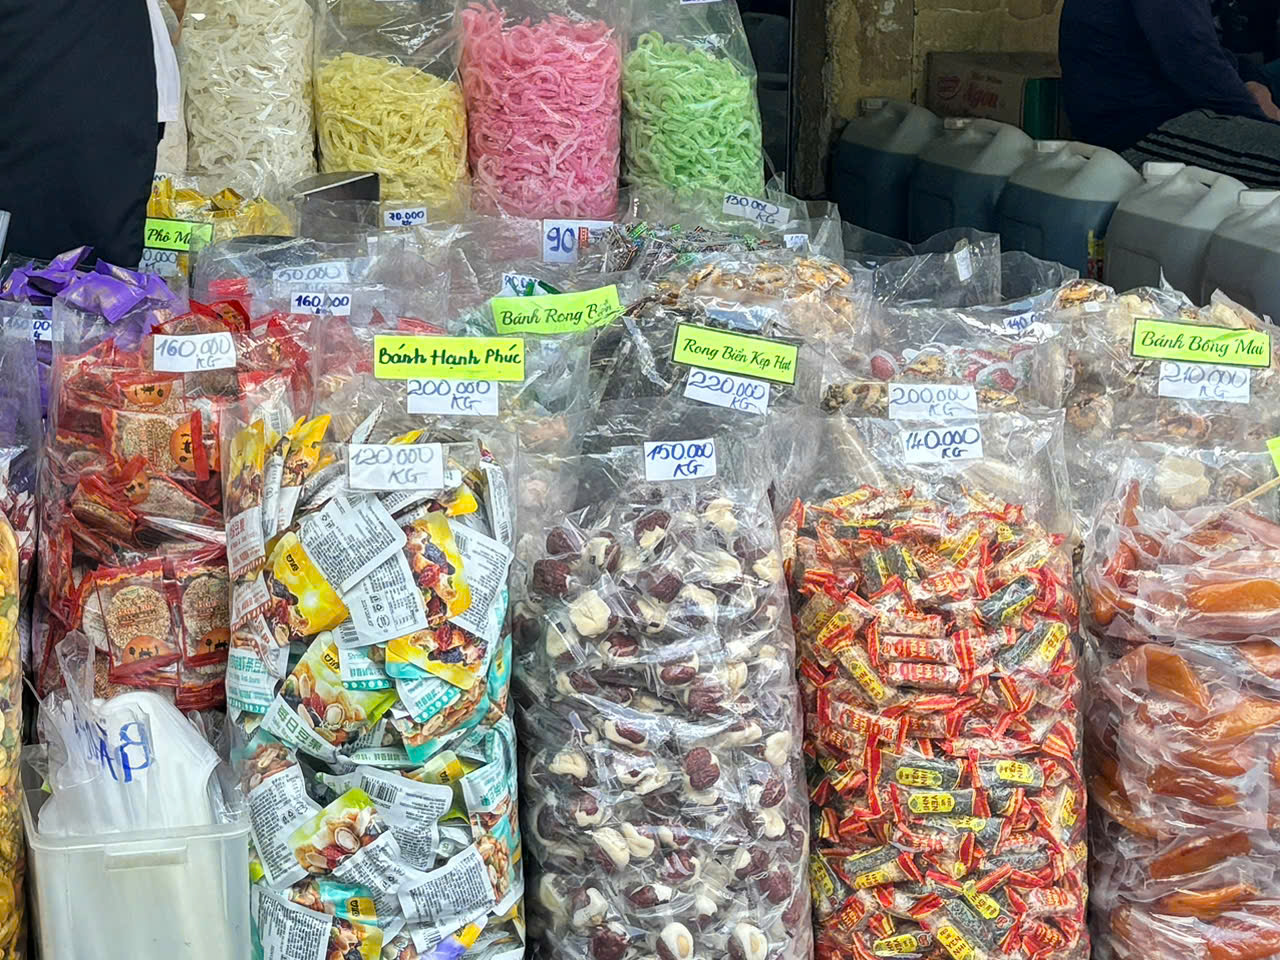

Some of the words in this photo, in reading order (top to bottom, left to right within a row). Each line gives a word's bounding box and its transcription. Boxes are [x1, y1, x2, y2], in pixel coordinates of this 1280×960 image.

[499, 309, 541, 327] Bánh
[544, 307, 583, 326] Rong
[155, 336, 233, 359] 160.000
[683, 338, 719, 360] Rong
[1141, 332, 1185, 350] Bánh
[378, 343, 427, 365] Bánh
[430, 349, 480, 370] Hạnh
[484, 344, 522, 365] Phúc
[673, 459, 705, 477] KG
